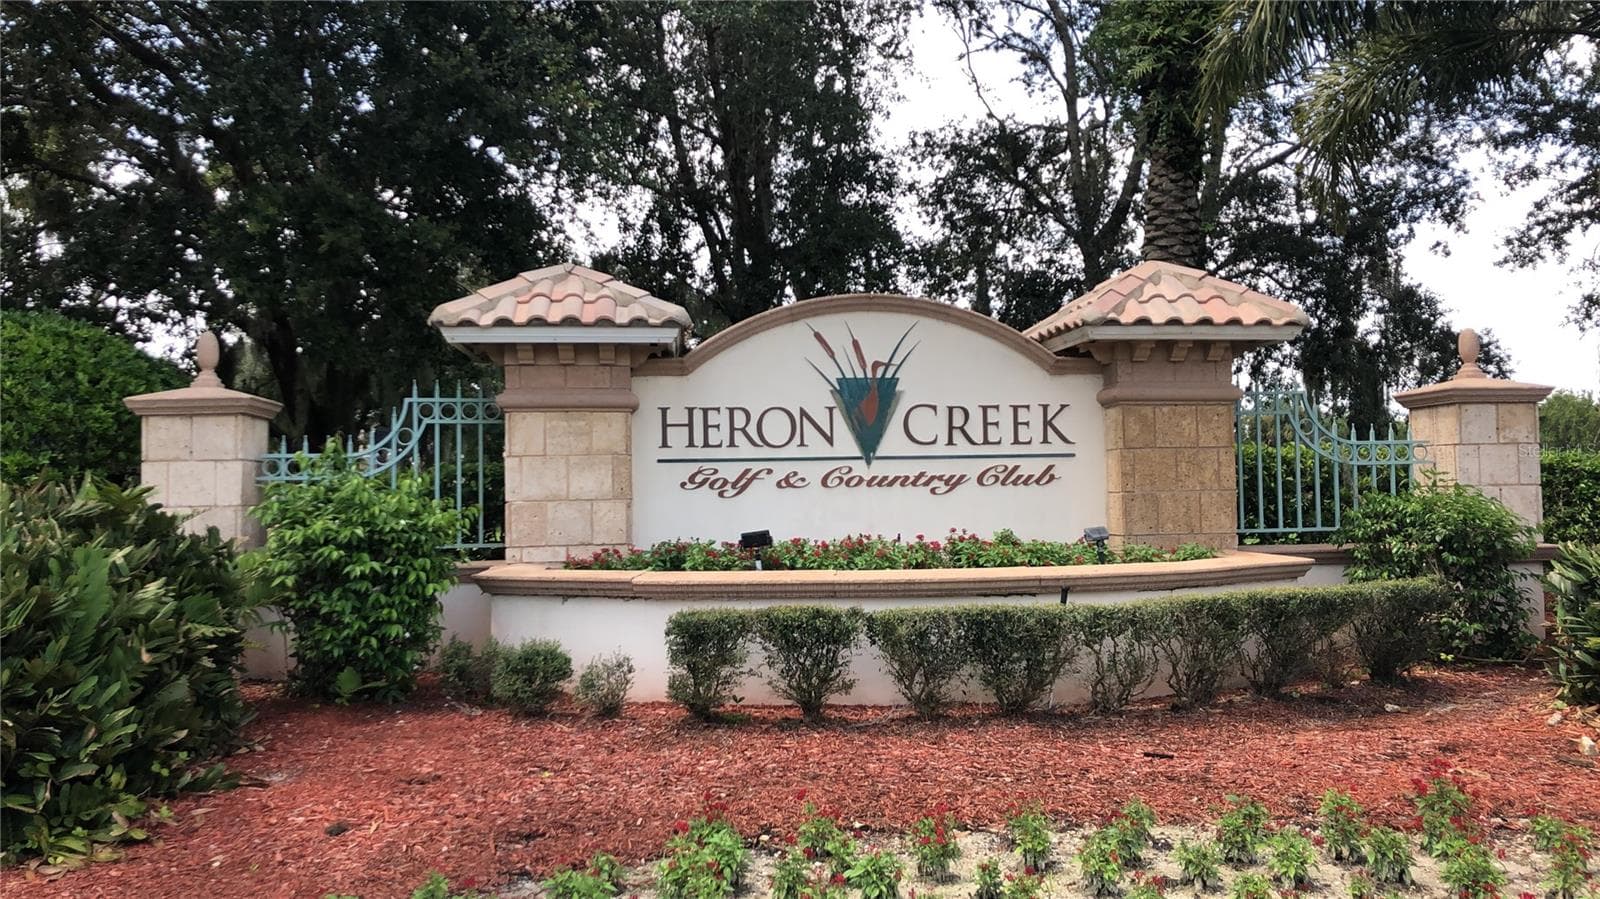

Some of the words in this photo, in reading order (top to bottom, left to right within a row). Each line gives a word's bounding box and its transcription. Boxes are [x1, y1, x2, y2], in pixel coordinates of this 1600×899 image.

[658, 405, 835, 449] HERON
[902, 403, 1076, 446] CREEK
[679, 465, 773, 499] Golf
[776, 470, 811, 489] &
[820, 465, 971, 496] Country
[976, 464, 1062, 487] Club
